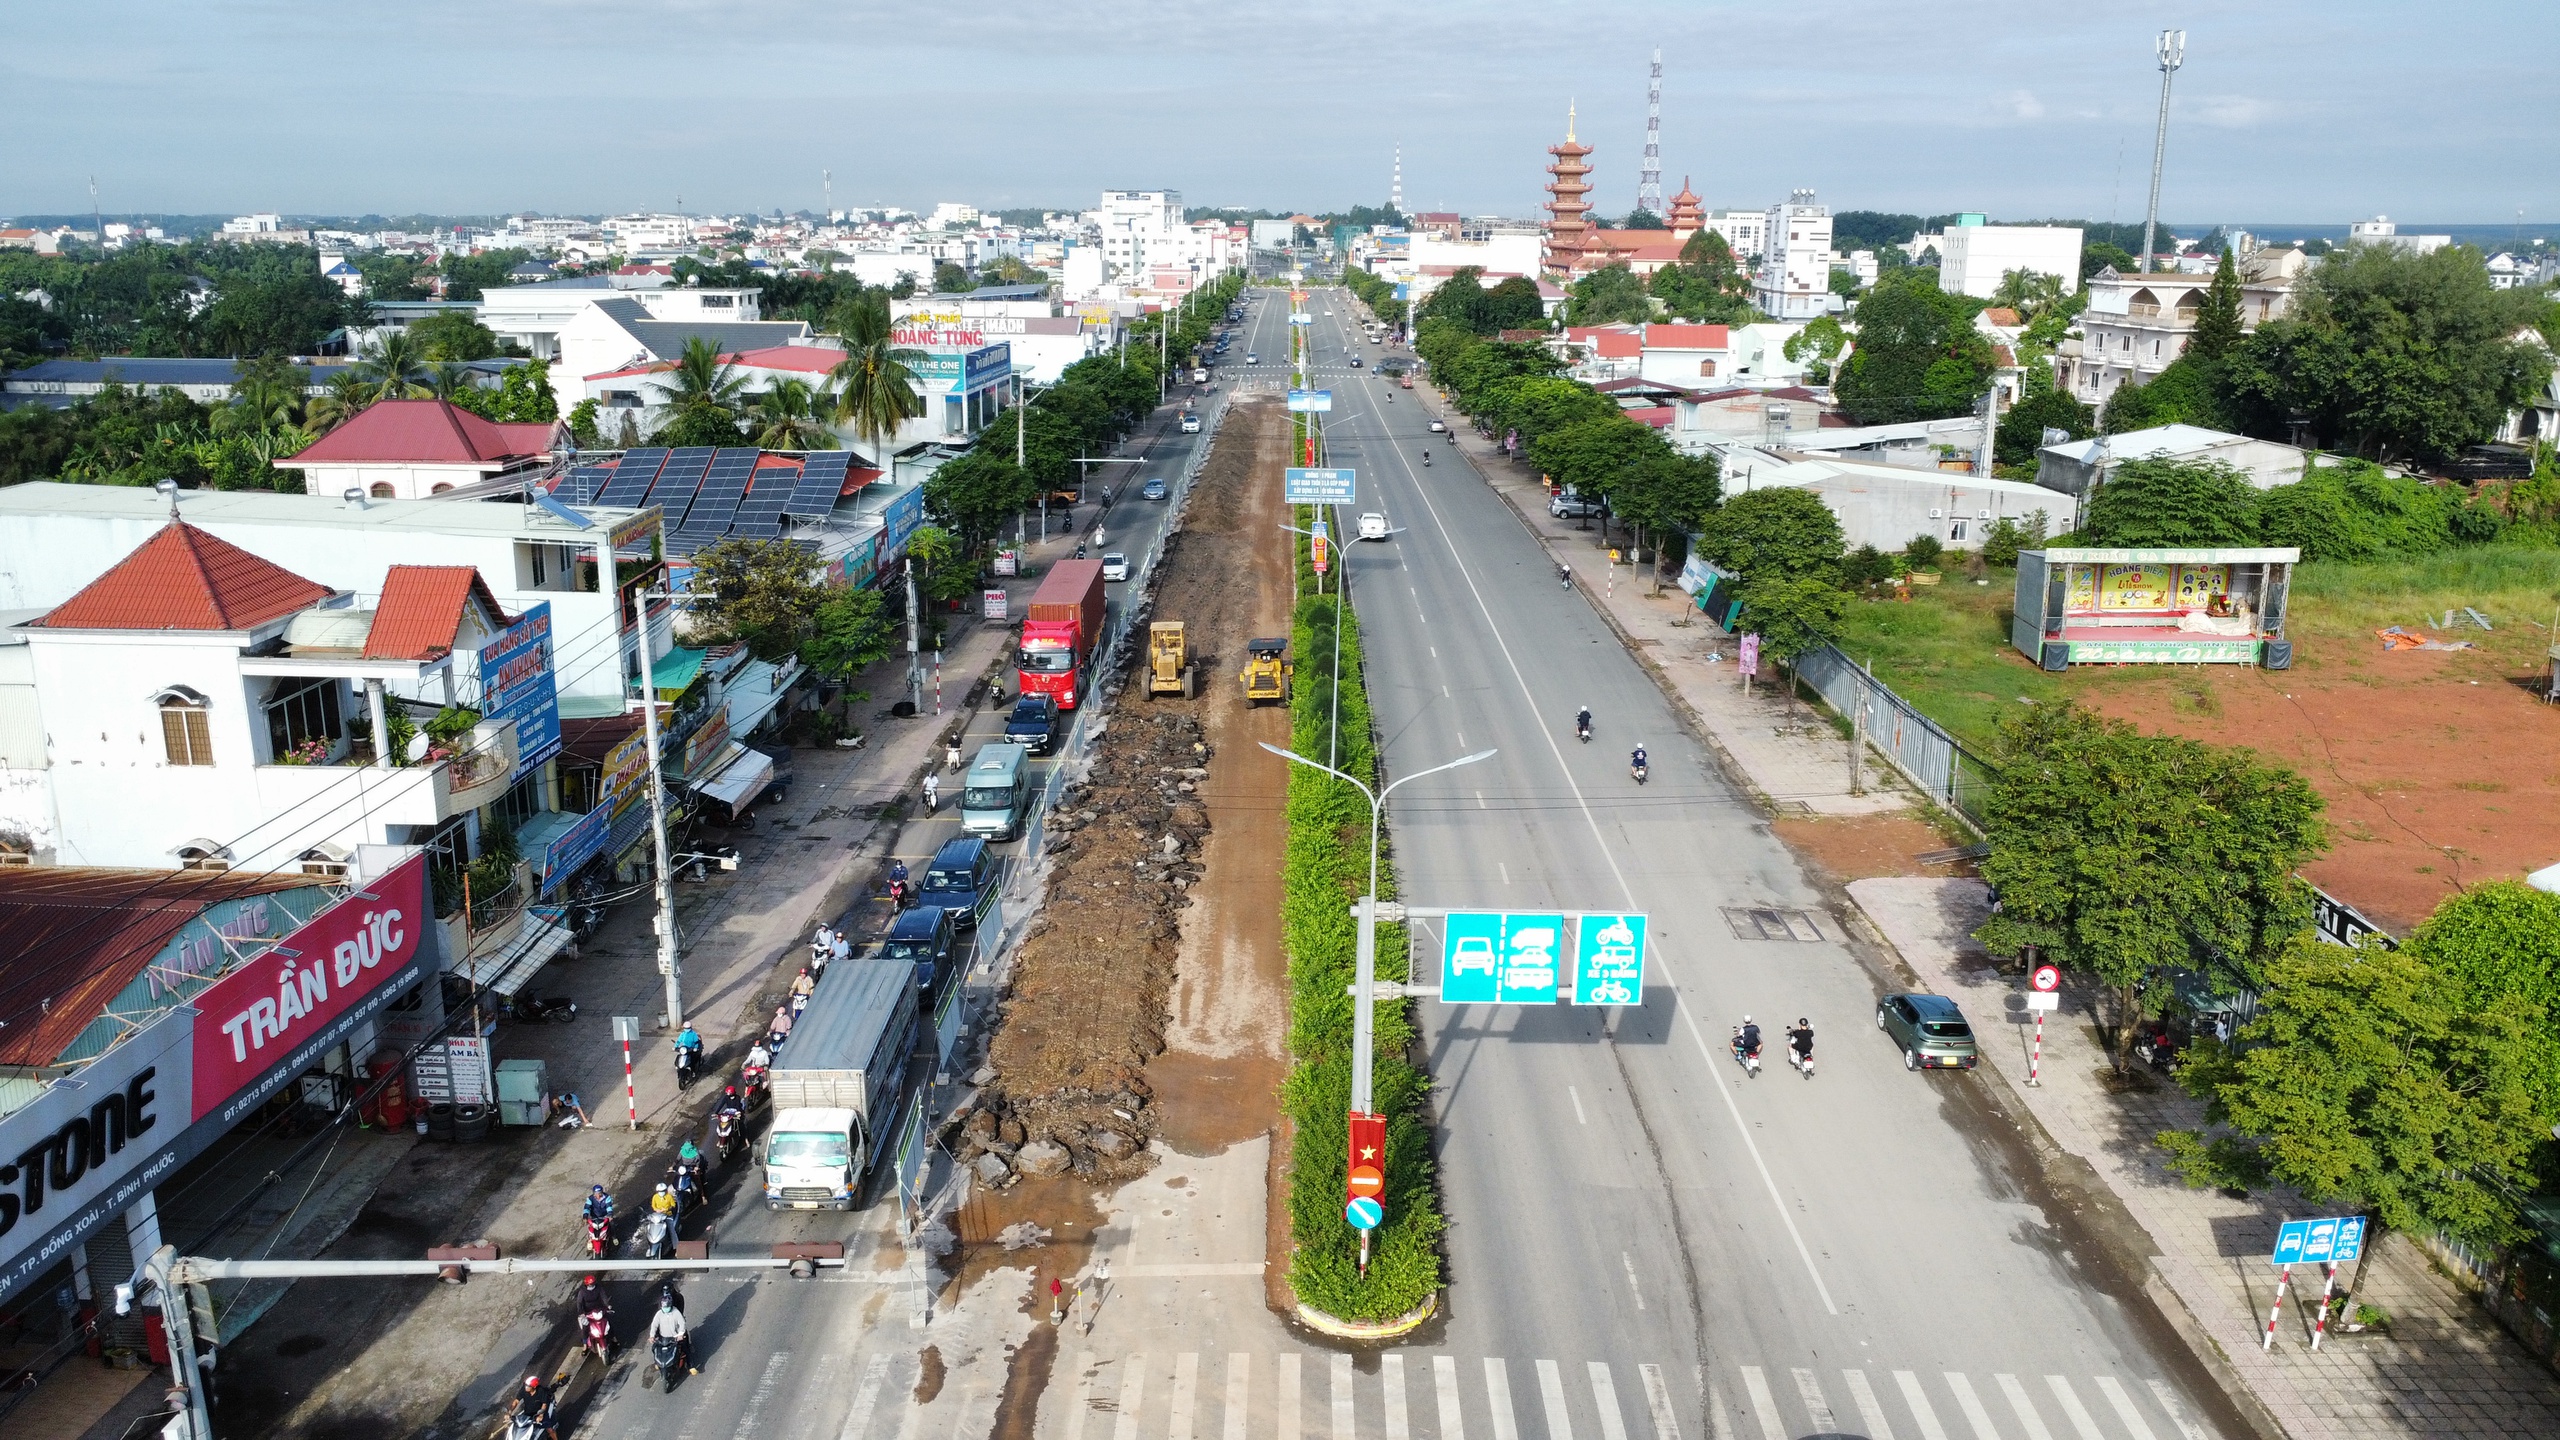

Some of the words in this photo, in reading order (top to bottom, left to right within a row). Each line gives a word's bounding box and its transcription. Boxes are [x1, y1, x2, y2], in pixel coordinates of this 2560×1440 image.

[921, 361, 939, 369] THE
[941, 361, 960, 370] ONE
[2109, 564, 2141, 578] HOÀNG
[222, 959, 328, 1063] TRẦN
[334, 908, 405, 988] ĐỨC
[1587, 968, 1600, 979] XE
[1602, 969, 1609, 979] 3
[238, 1089, 260, 1110] 02713
[260, 1077, 274, 1093] 879
[274, 1067, 287, 1083] 645
[291, 1052, 309, 1068] 0944
[309, 1042, 318, 1056] 07
[318, 1034, 327, 1047] 07
[327, 1027, 336, 1041] 07
[338, 1015, 354, 1033] 0913
[354, 1006, 367, 1021] 937
[367, 996, 379, 1012] 010
[20, 1256, 40, 1275] TP.
[41, 1229, 73, 1261] ĐỒNG
[75, 1208, 99, 1235] XOÀI
[117, 1177, 140, 1202] BÌNH
[143, 1151, 175, 1183] PHƯỚC
